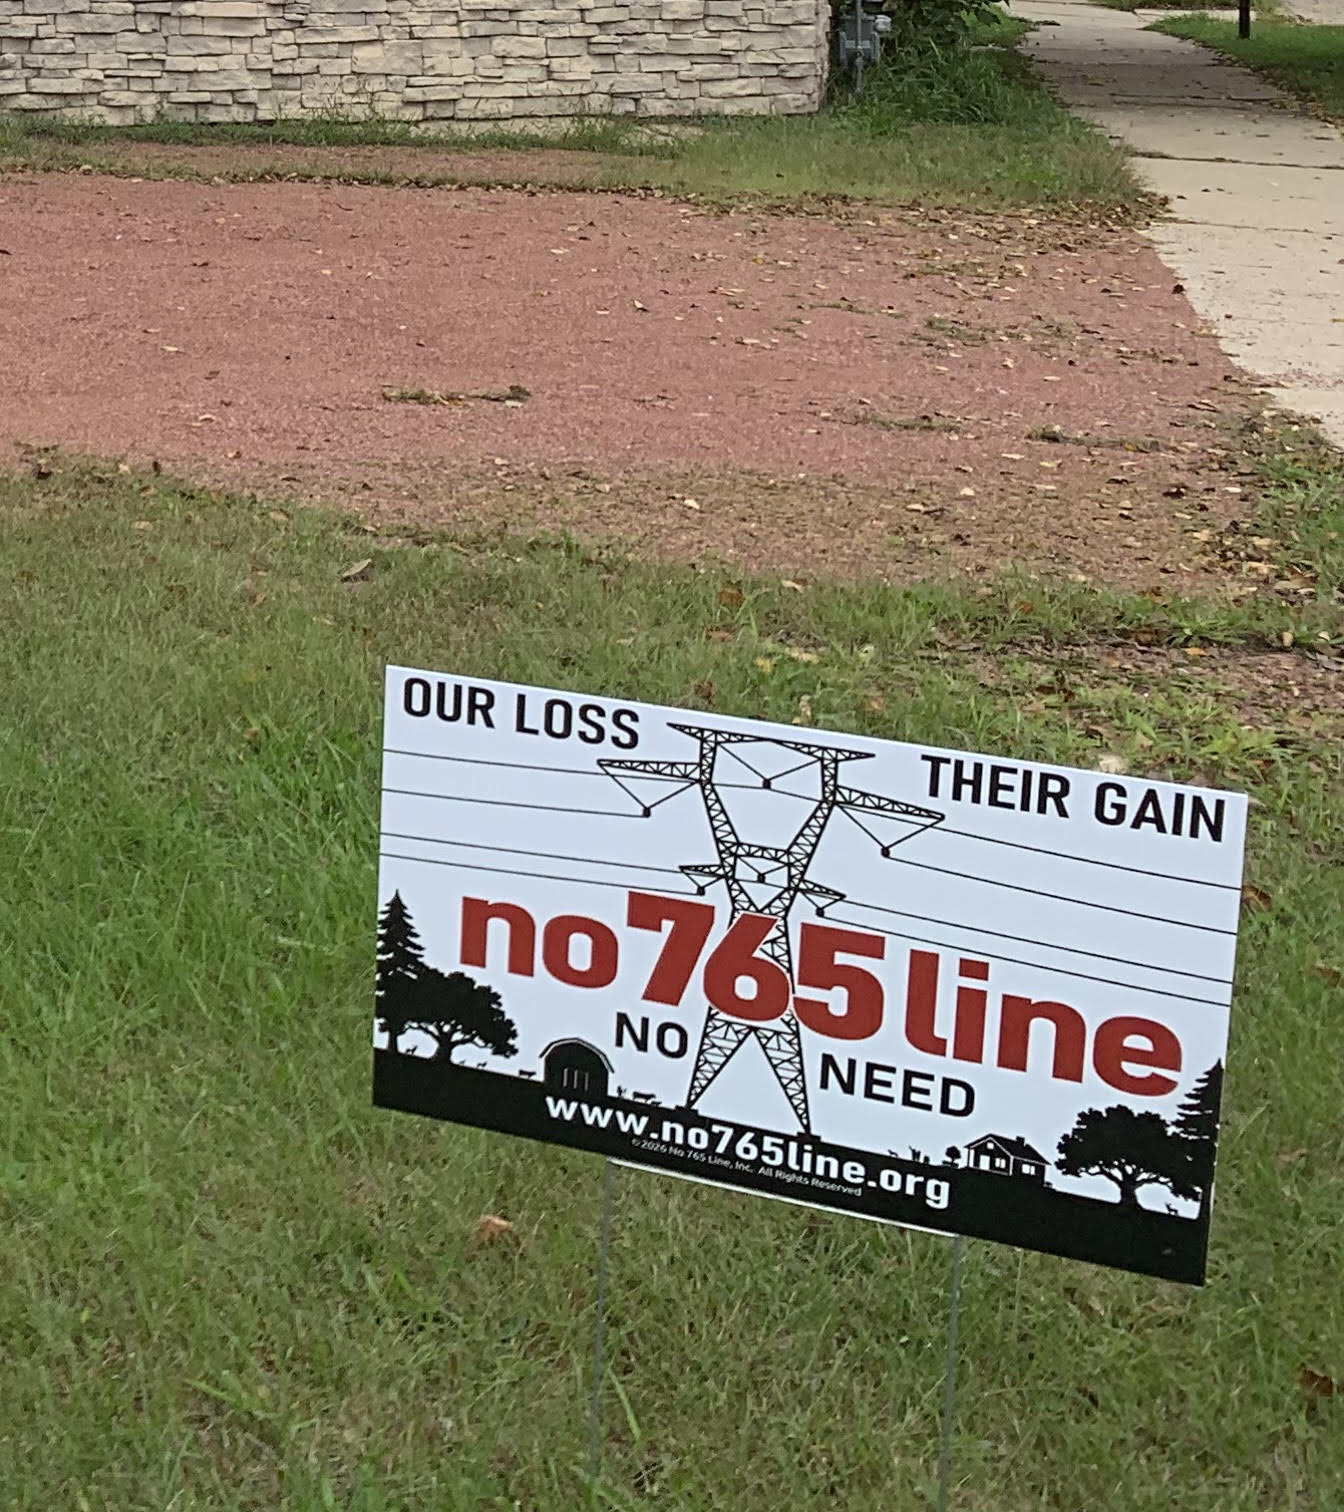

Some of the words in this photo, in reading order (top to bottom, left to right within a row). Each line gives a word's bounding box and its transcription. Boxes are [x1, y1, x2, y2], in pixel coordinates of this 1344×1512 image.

[404, 677, 496, 729] OUR
[516, 694, 640, 750] LOSS
[921, 754, 1070, 819] THEIR
[1094, 781, 1226, 843] GAIN
[460, 891, 1182, 1097] no765line
[615, 1011, 688, 1059] NO
[819, 1053, 976, 1118] NEED
[545, 1096, 951, 1210] www.no765line.org
[669, 1145, 684, 1159] No
[687, 1149, 706, 1163] 765
[708, 1154, 733, 1170] Line,
[735, 1161, 754, 1174] Inc.
[758, 1166, 774, 1178] All
[775, 1170, 810, 1186] Rights
[811, 1177, 862, 1197] Reserved
